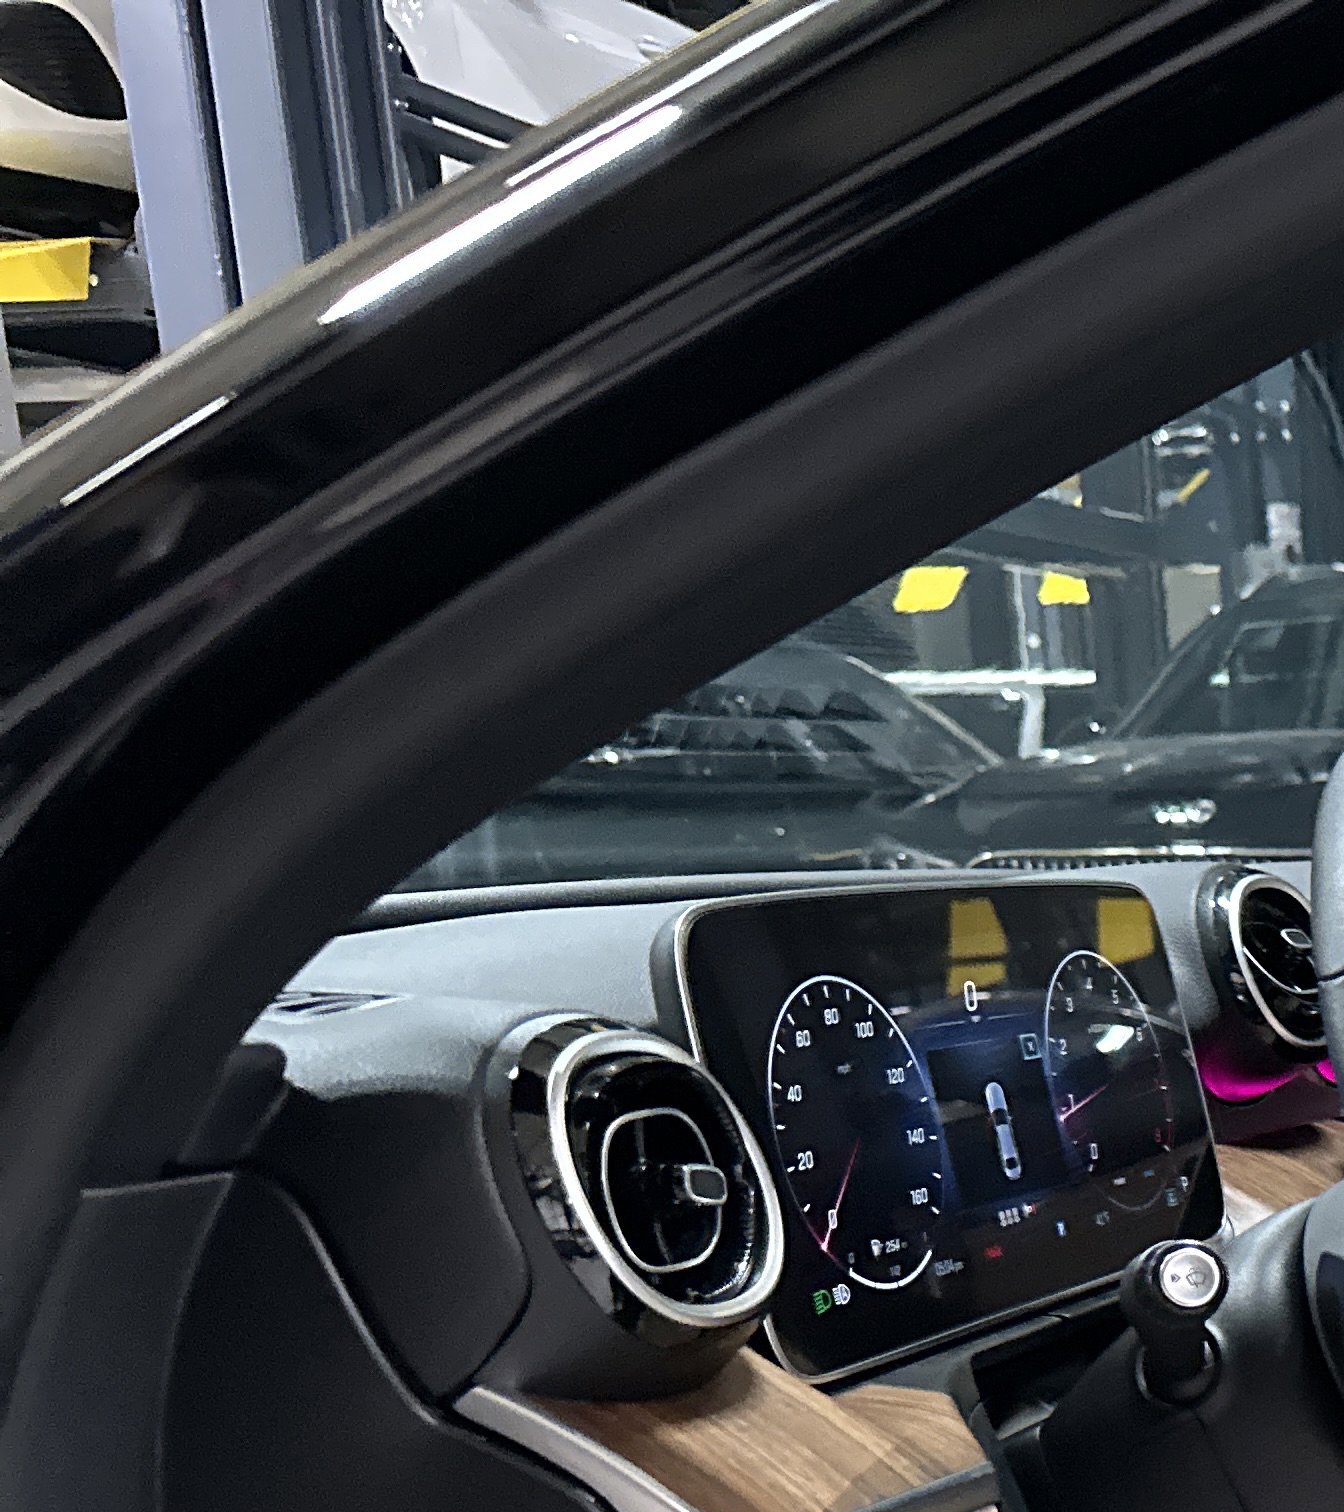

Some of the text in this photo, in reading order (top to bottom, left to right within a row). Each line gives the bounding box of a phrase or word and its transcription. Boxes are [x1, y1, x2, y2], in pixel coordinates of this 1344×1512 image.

[964, 981, 978, 1011] 0
[1066, 997, 1074, 1013] 3
[824, 1008, 839, 1025] 80
[855, 1021, 874, 1038] 100
[795, 1030, 811, 1047] 60
[886, 1068, 905, 1084] 120
[787, 1085, 802, 1101] 40
[906, 1128, 925, 1146] 140
[1089, 1143, 1098, 1159] 0
[798, 1151, 814, 1170] 20
[910, 1188, 928, 1205] 160
